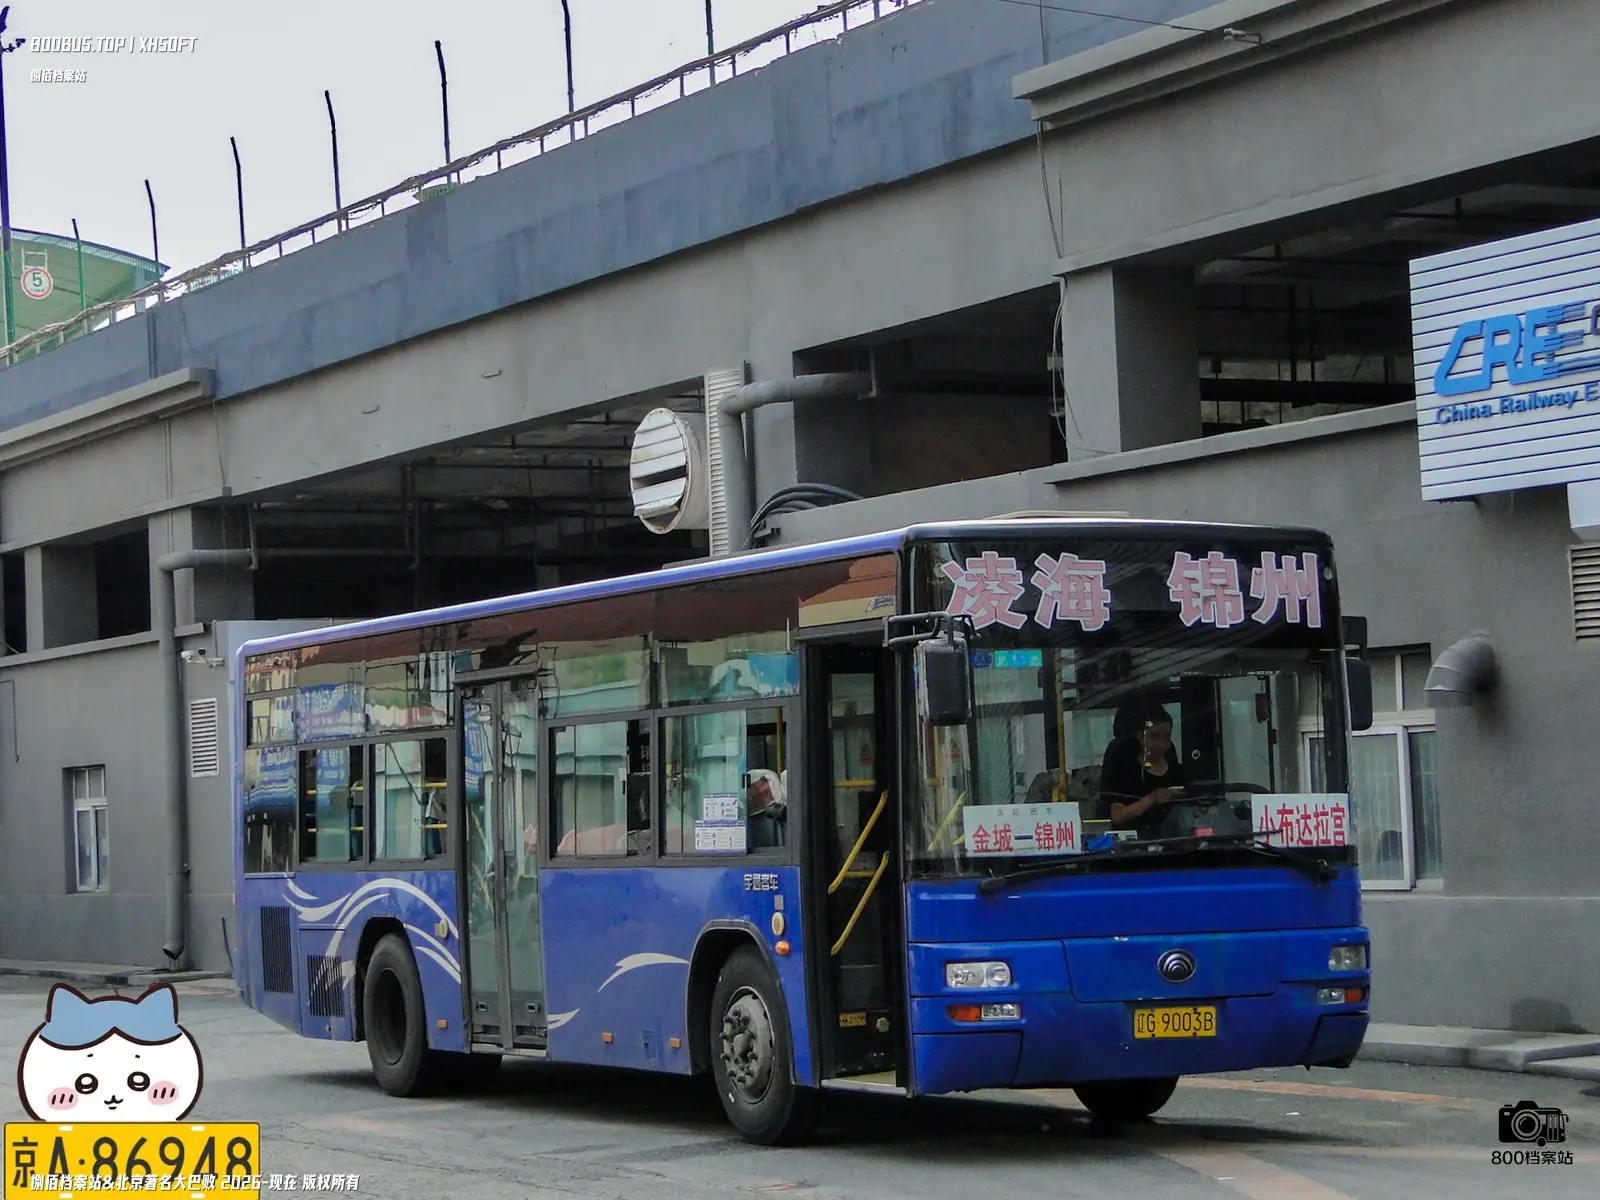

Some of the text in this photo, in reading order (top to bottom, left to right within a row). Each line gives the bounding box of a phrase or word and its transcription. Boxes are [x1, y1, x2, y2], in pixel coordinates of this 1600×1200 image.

[32, 271, 43, 287] 5
[1436, 402, 1493, 425] China
[1498, 389, 1578, 415] Railway
[940, 550, 1322, 632] 凌海 锦州
